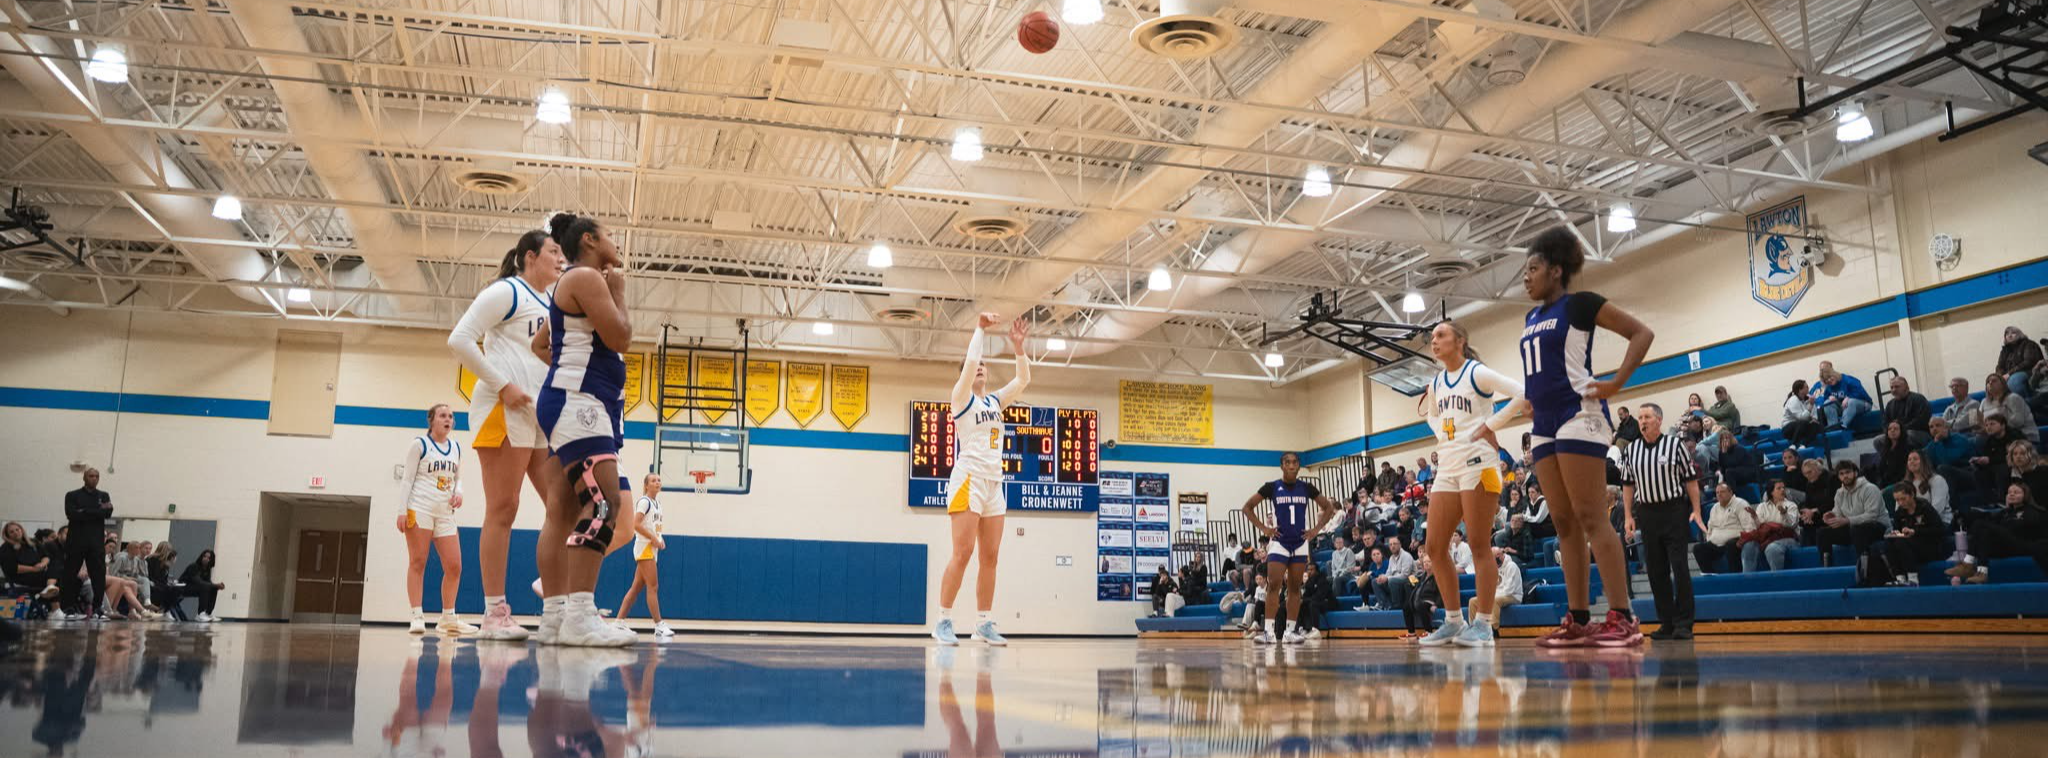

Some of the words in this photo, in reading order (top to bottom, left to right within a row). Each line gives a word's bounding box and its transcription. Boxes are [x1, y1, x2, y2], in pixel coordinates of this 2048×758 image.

[1753, 206, 1801, 243] LAWTON
[1523, 336, 1542, 376] 11
[914, 403, 927, 411] PLY
[930, 403, 939, 411] FL
[921, 412, 928, 421] 2
[930, 412, 937, 422] 0
[946, 412, 953, 423] 0
[1002, 408, 1030, 423] :44
[1058, 409, 1071, 417] PLY
[1073, 410, 1081, 418] FL
[1083, 410, 1096, 419] PTS
[921, 423, 928, 432] 3
[930, 423, 937, 433] 0
[946, 423, 953, 434] 0
[1074, 419, 1081, 429] 0
[1089, 420, 1096, 429] 0
[1442, 417, 1456, 441] 4
[1016, 427, 1053, 436] SOUTHHAVE
[1065, 430, 1072, 438] 4
[1077, 430, 1080, 438] 1
[1089, 430, 1096, 440] 0
[921, 434, 928, 443] 4
[930, 434, 937, 444] 0
[946, 434, 953, 445] 0
[989, 427, 1000, 450] 2
[1007, 438, 1011, 450] 1
[930, 445, 937, 455] 0
[946, 445, 953, 456] 0
[1042, 437, 1052, 454] 0
[1062, 440, 1072, 450] 10
[1074, 440, 1081, 450] 0
[1089, 440, 1096, 451] 0
[914, 455, 928, 465] 24
[933, 456, 936, 465] 1
[946, 456, 953, 467] 0
[1062, 451, 1072, 459] 11
[1074, 451, 1081, 461] 0
[1089, 451, 1096, 461] 0
[933, 467, 936, 476] 1
[1017, 461, 1021, 472] 1
[1048, 462, 1052, 473] 1
[1062, 462, 1072, 471] 12
[1074, 462, 1081, 471] 0
[1089, 462, 1096, 472] 0
[1077, 473, 1081, 481] 1
[1021, 484, 1040, 496] BILL
[1043, 485, 1049, 496] &
[1052, 485, 1083, 496] JEANNE
[1021, 496, 1083, 509] CRONENWETT
[1276, 496, 1292, 504] SOUTH
[1288, 504, 1296, 525] 1
